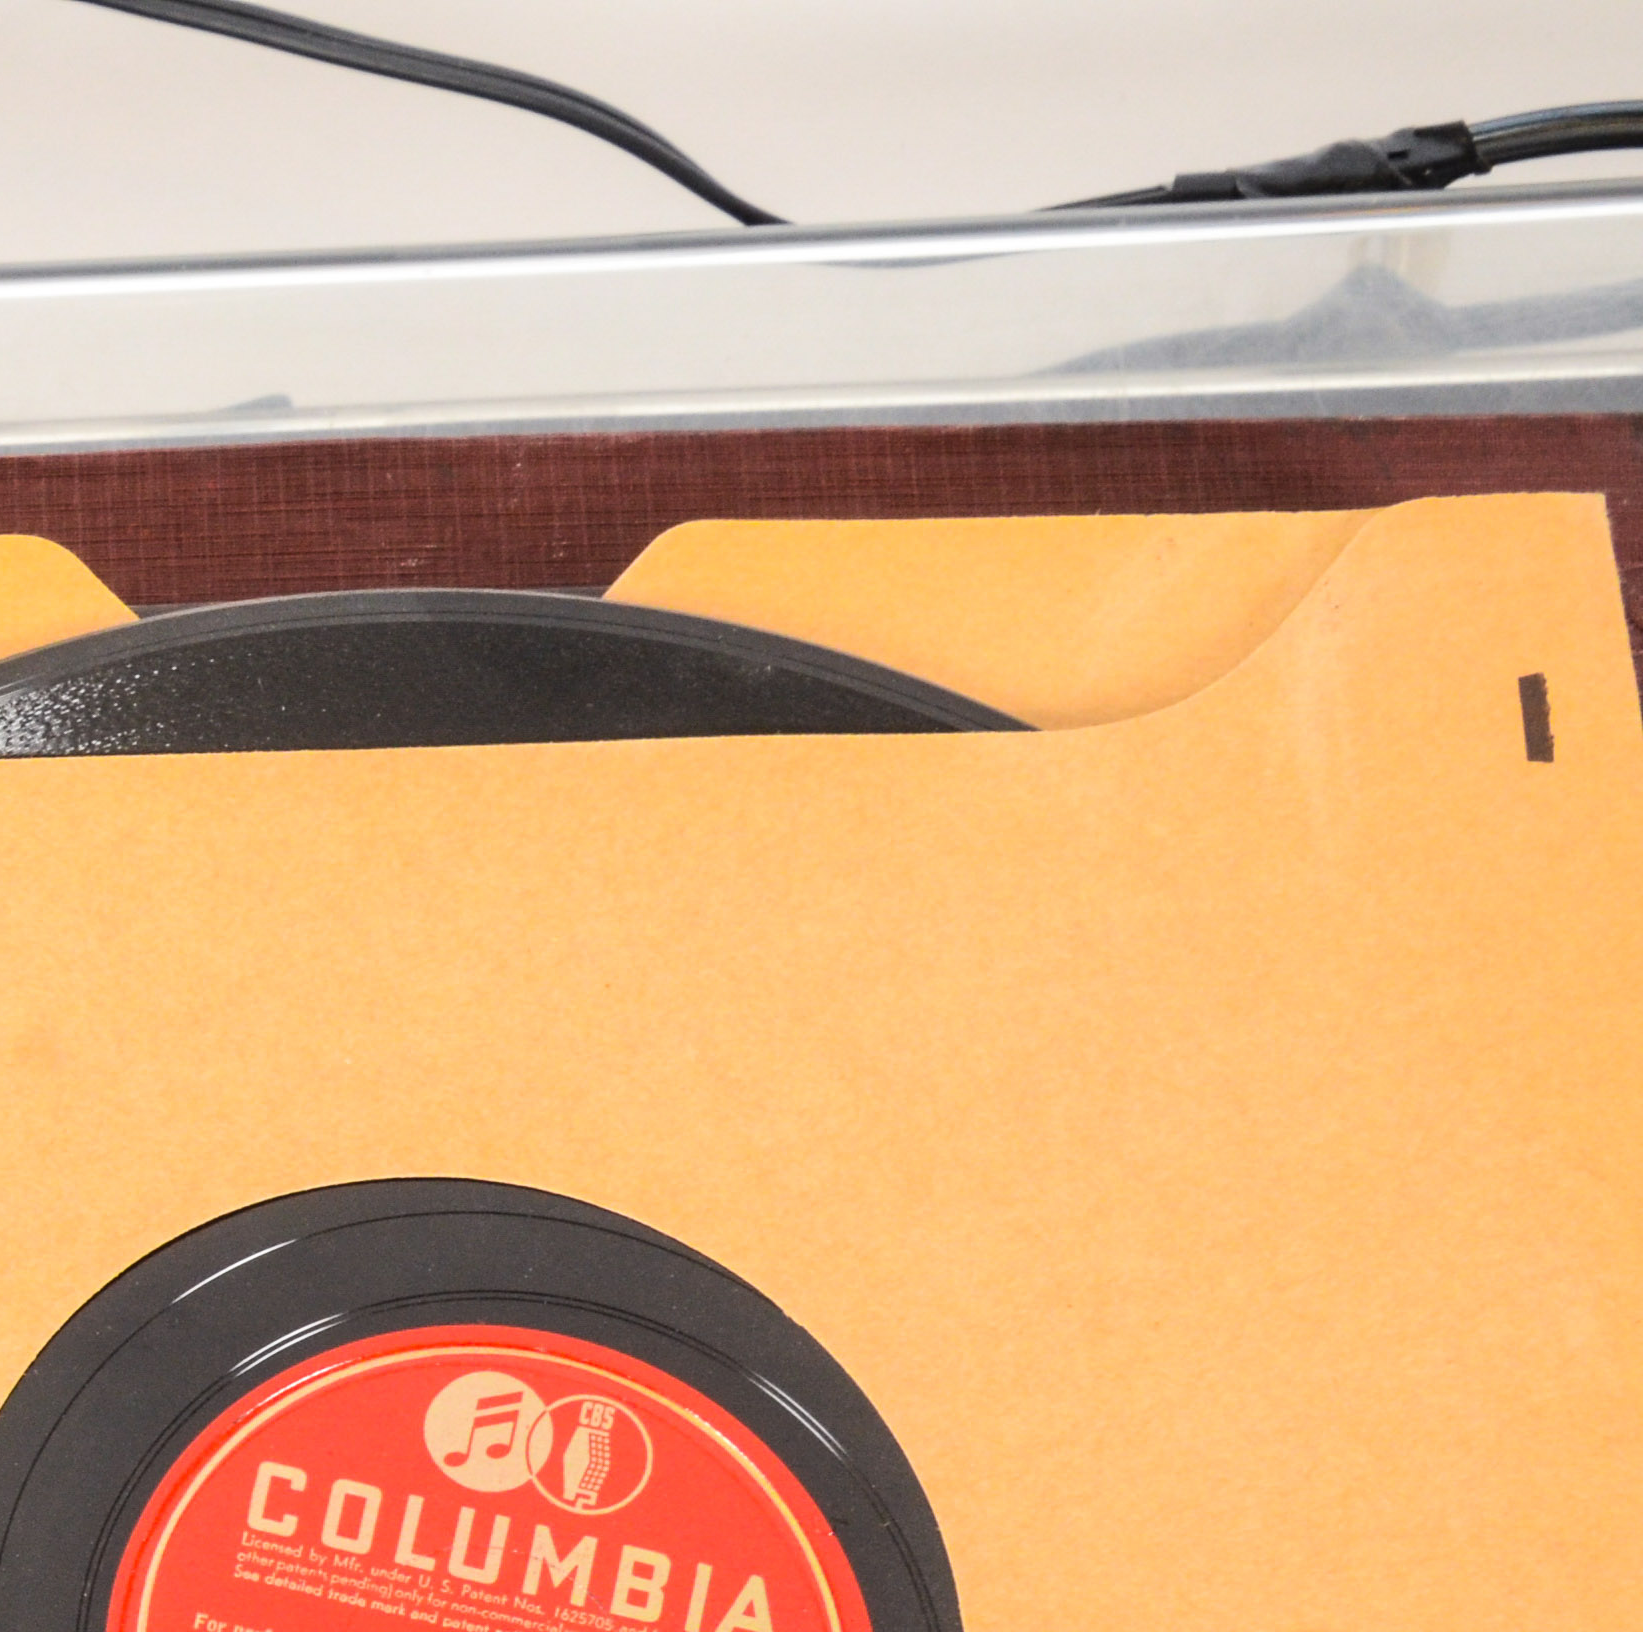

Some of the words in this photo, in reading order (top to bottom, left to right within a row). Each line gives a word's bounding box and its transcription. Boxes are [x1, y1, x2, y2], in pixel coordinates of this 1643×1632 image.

[579, 1399, 615, 1431] CBS
[234, 1564, 260, 1582] See
[264, 1572, 324, 1598] detailed
[328, 1588, 367, 1608] trade
[371, 1600, 407, 1617] mark
[411, 1607, 438, 1625] and
[236, 1550, 274, 1569] other
[394, 1588, 424, 1606] only
[427, 1591, 447, 1609] for
[241, 1531, 303, 1558] Licensed
[309, 1545, 328, 1565] by
[333, 1554, 364, 1573] Mfr.
[371, 1566, 412, 1584] under
[418, 1575, 434, 1590] U.
[440, 1580, 454, 1595] S.
[462, 1583, 508, 1605] Patent
[554, 1607, 615, 1631] 1625705
